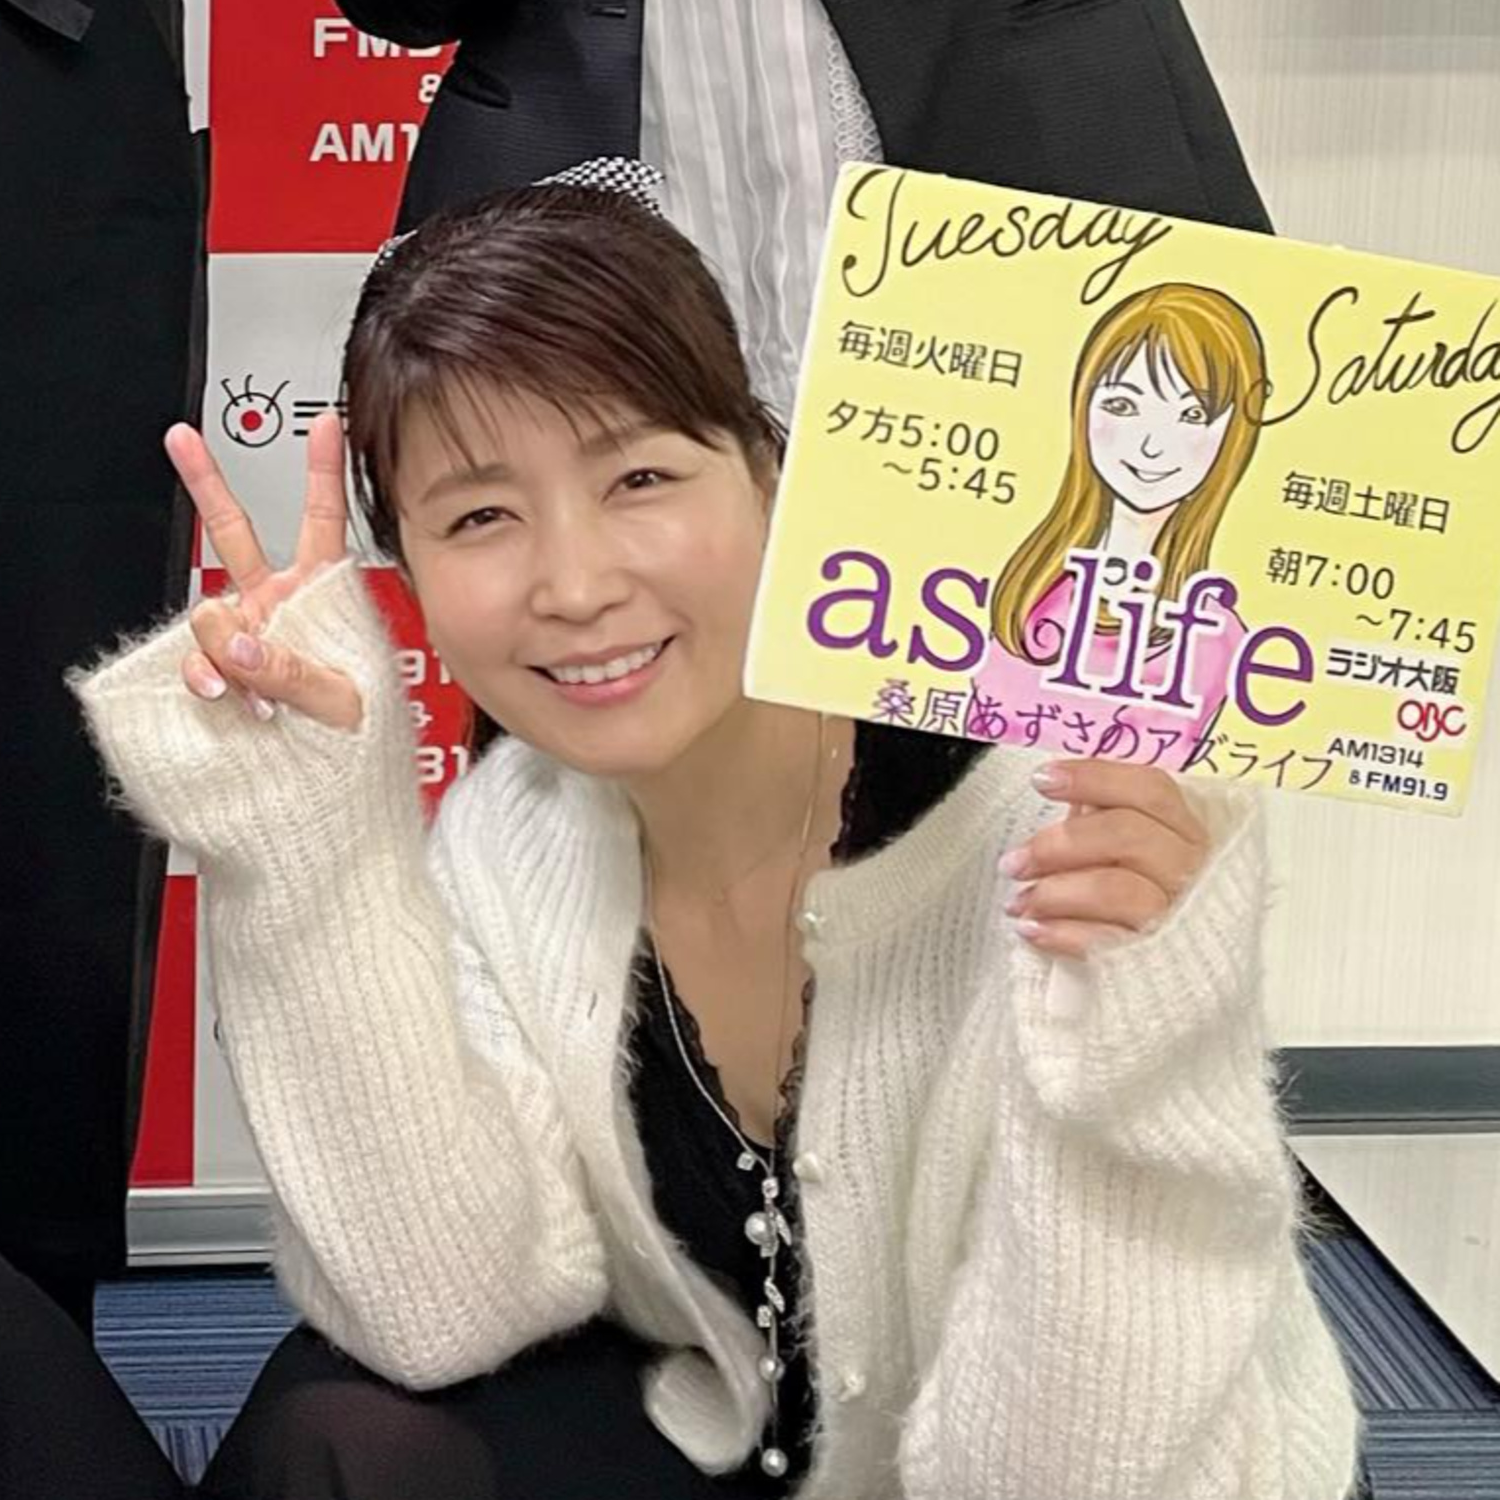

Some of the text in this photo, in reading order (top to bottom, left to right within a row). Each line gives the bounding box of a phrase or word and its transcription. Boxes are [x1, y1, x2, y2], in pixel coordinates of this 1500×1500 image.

[842, 168, 1173, 305] Tuesday
[837, 319, 1024, 388] 毎週火曜日
[1282, 471, 1450, 534] 毎週土曜日
[806, 550, 1315, 726] as life
[1327, 647, 1461, 696] ラジオ大阪
[872, 677, 1334, 790] 桑原あずさのアズライフ
[1328, 737, 1424, 768] AM1314
[1397, 700, 1467, 742] OBC
[1366, 771, 1449, 801] FM91.9
